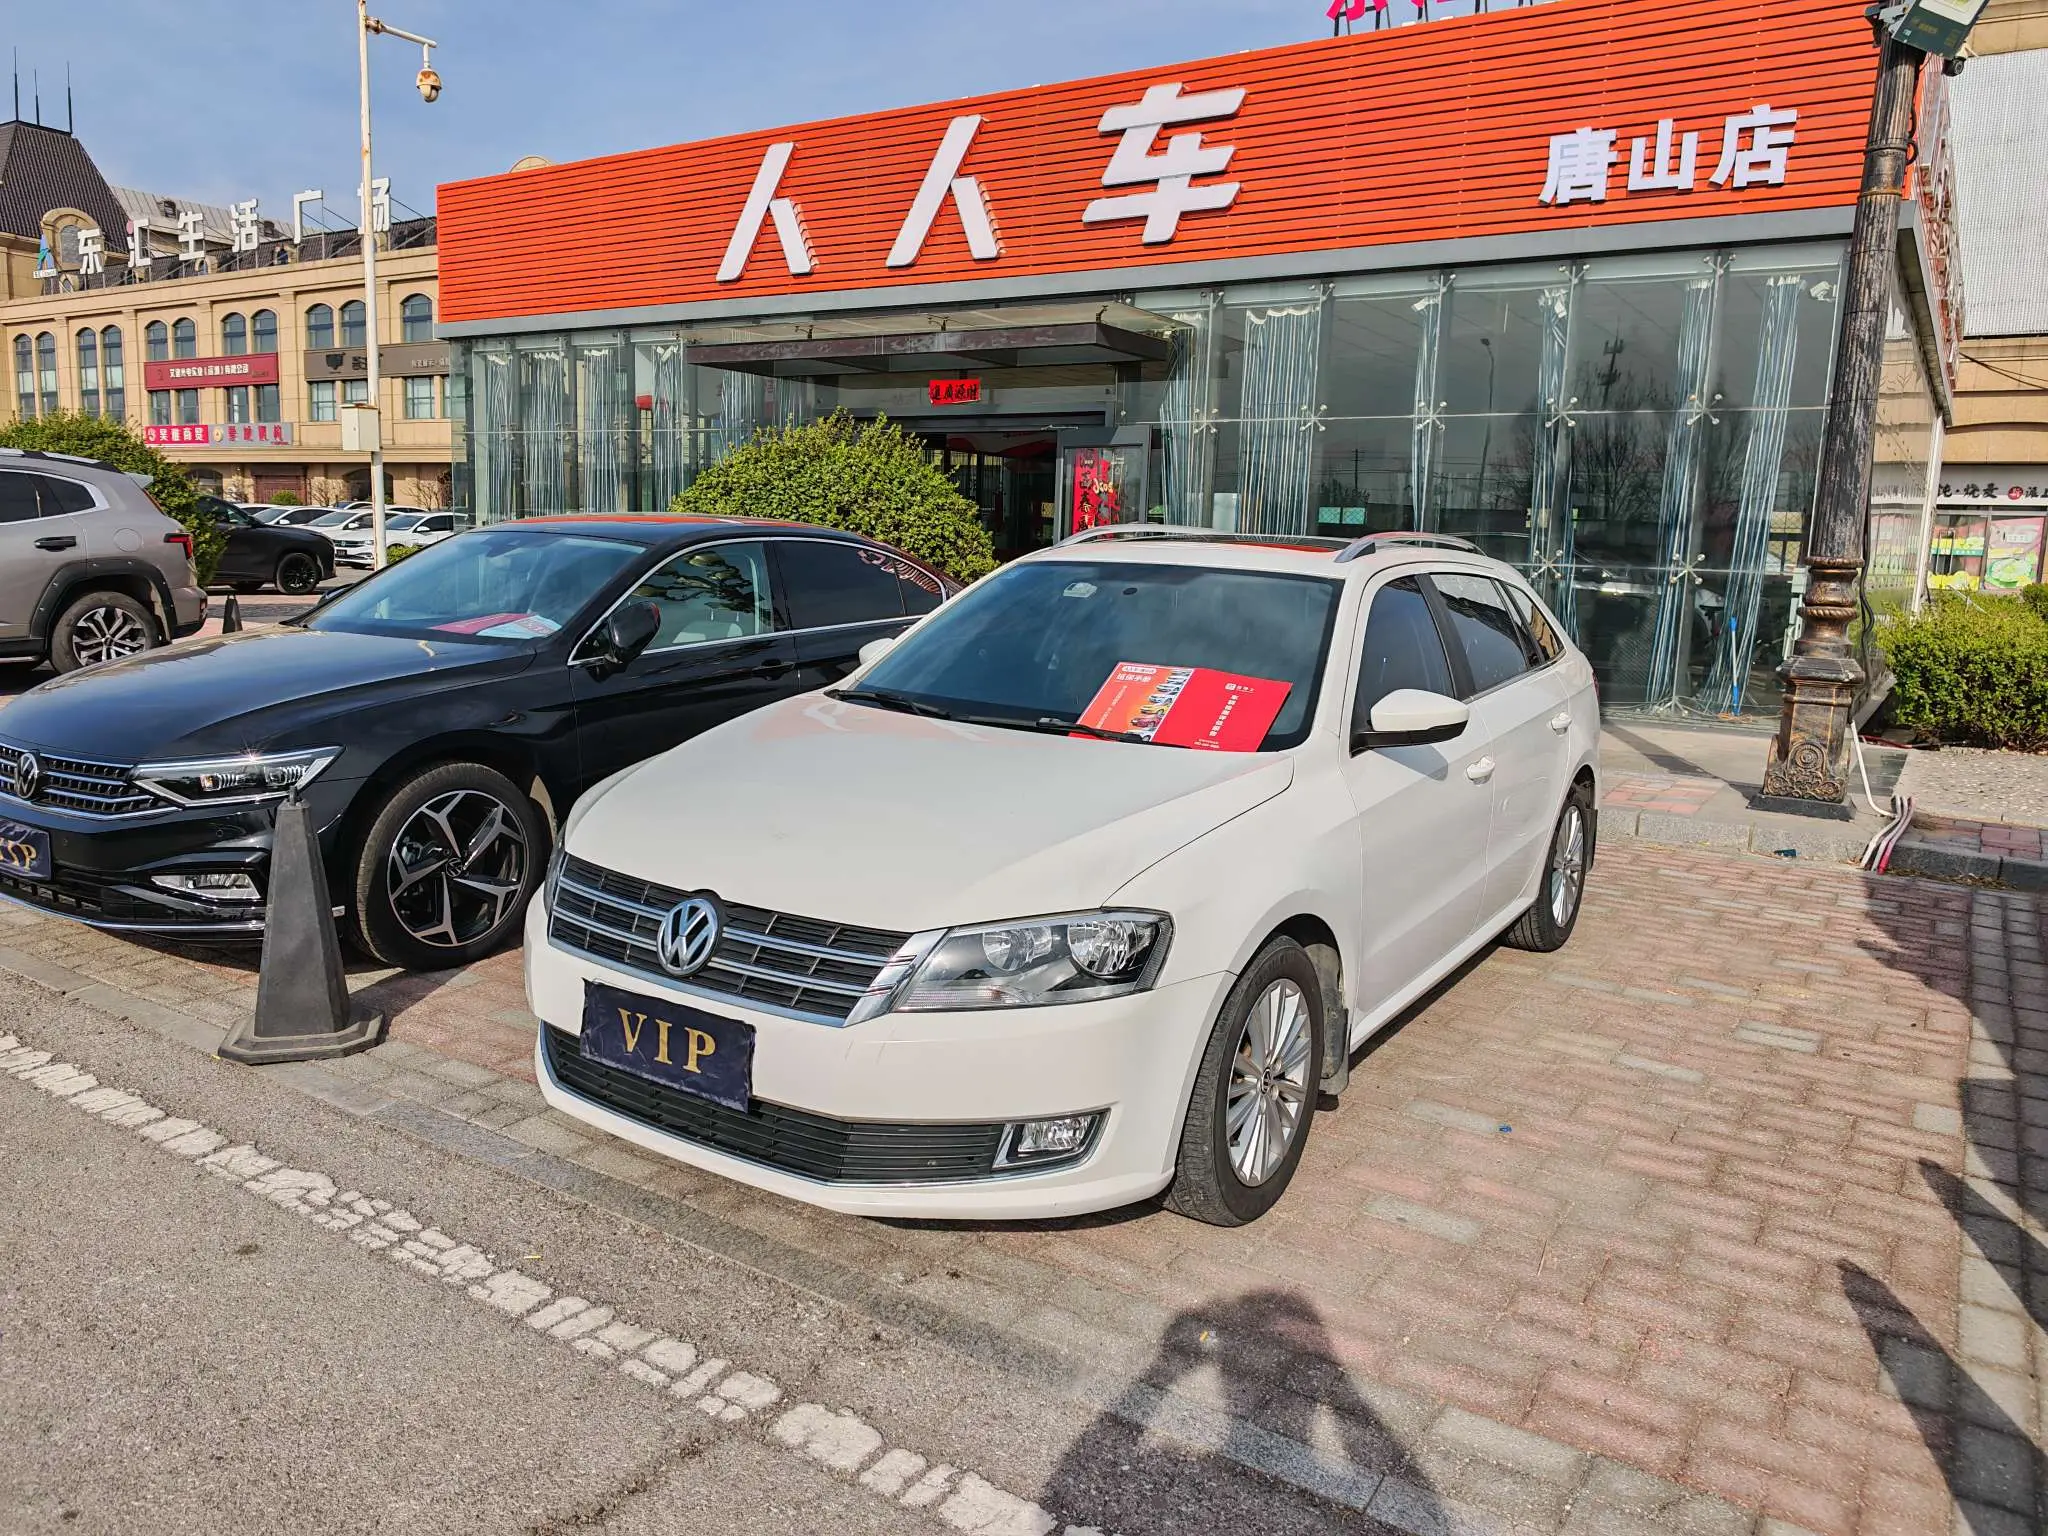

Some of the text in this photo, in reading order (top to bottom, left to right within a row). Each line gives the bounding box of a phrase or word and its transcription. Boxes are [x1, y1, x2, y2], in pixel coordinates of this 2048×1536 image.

[716, 82, 1247, 282] 人人车
[1538, 104, 1798, 206] 唐山店
[0, 837, 37, 873] IP
[617, 1007, 716, 1074] VIP
